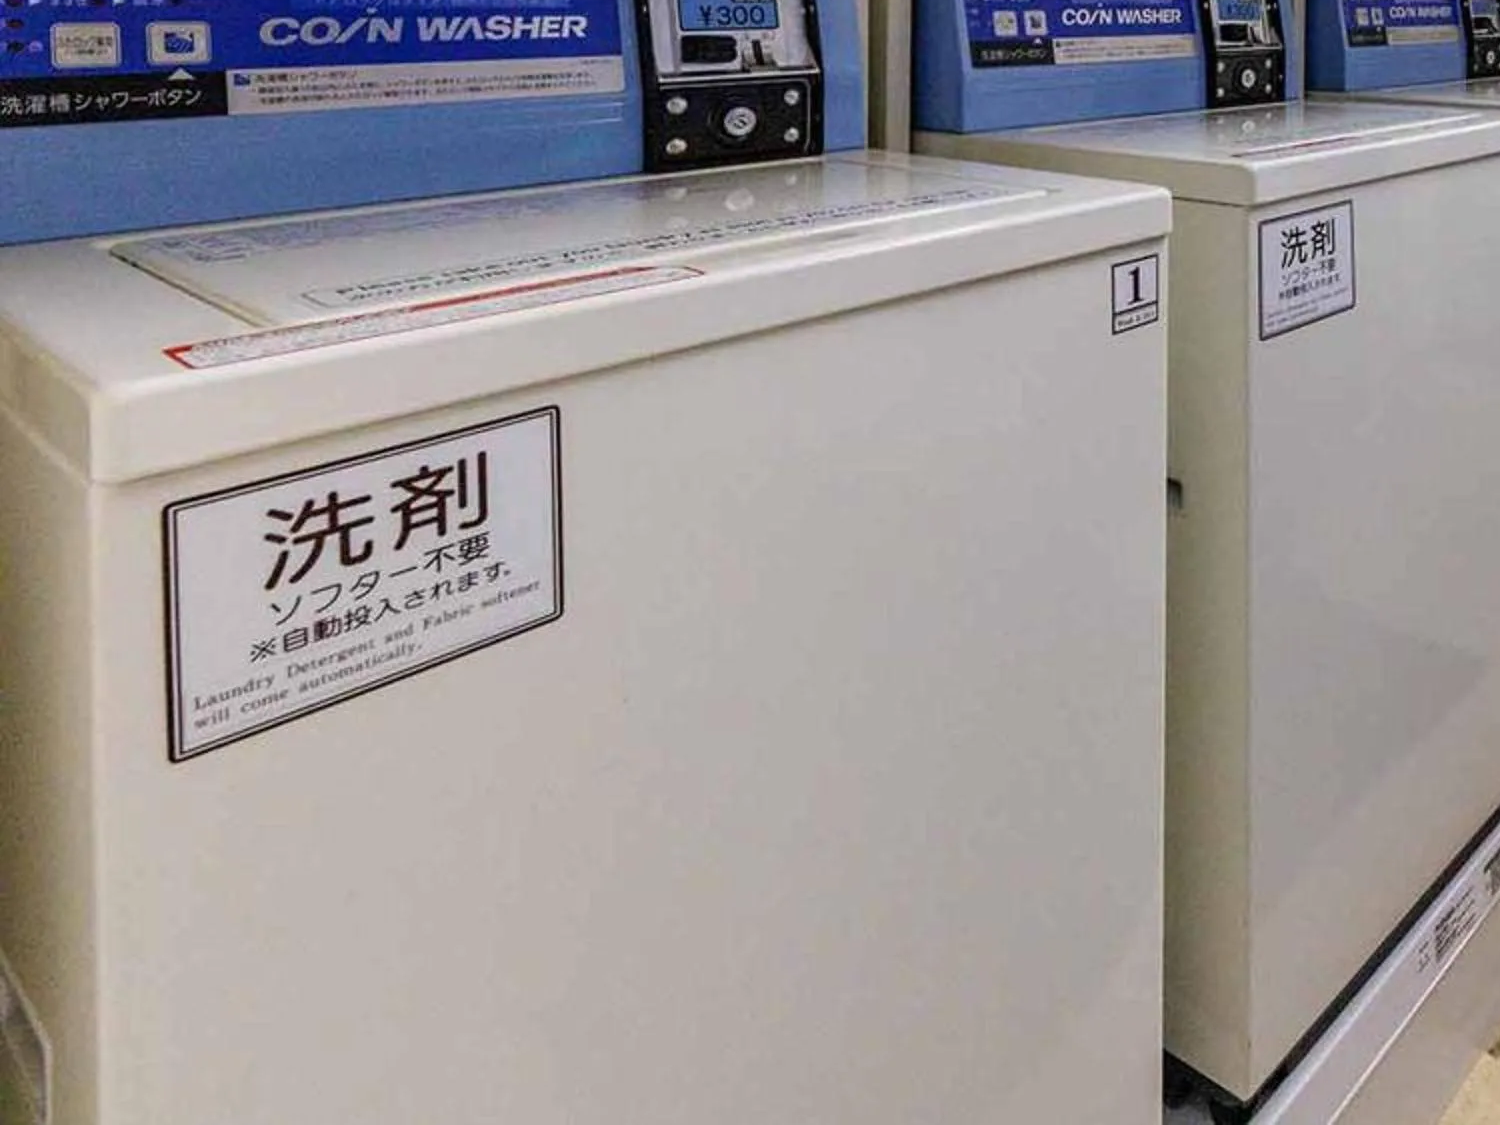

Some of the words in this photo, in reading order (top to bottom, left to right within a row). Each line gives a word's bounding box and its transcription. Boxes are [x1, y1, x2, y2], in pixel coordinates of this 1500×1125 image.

[259, 11, 404, 47] COIN
[416, 14, 589, 40] WASHER
[699, 4, 766, 27] ¥300
[1062, 4, 1113, 26] COIN
[1117, 7, 1183, 25] WASHER
[1, 88, 202, 116] 洗濯槽シャワーボタン
[1281, 218, 1336, 269] 洗剤
[1128, 266, 1145, 306] 1
[263, 450, 489, 592] 洗剤
[270, 531, 491, 627] ソフター不要
[249, 561, 512, 663] ※自動投入されます。
[194, 667, 276, 712] Laundry
[287, 639, 376, 680] Detergent
[384, 622, 416, 646] and
[422, 603, 474, 632] Fabric
[480, 579, 541, 612] softener
[193, 707, 231, 729] will
[240, 688, 289, 715] come
[298, 641, 422, 694] automatically.
